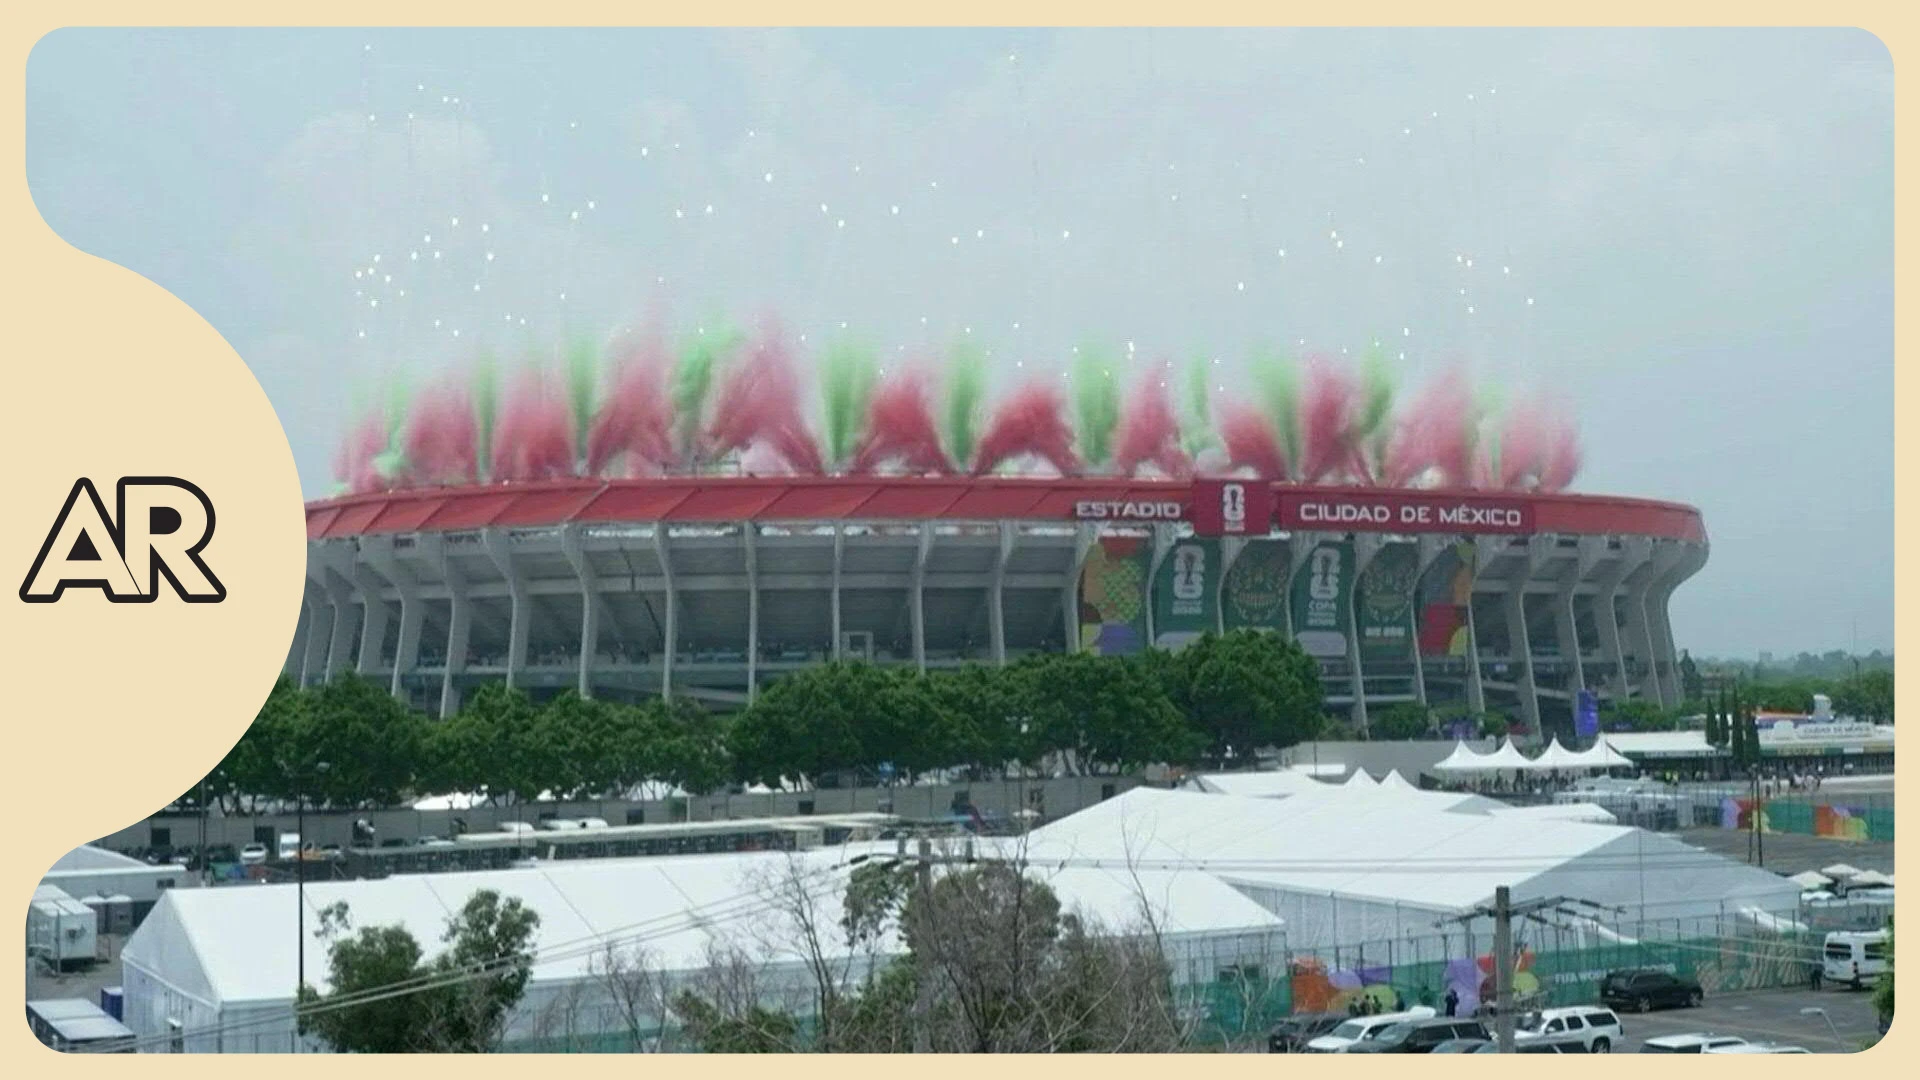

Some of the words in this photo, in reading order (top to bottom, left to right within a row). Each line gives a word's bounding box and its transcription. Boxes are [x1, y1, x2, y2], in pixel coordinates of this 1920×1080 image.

[1076, 502, 1181, 518] ESTADIO
[1300, 503, 1391, 523] CIUDAD
[1400, 506, 1431, 523] DE
[1439, 504, 1522, 526] MÉXICO
